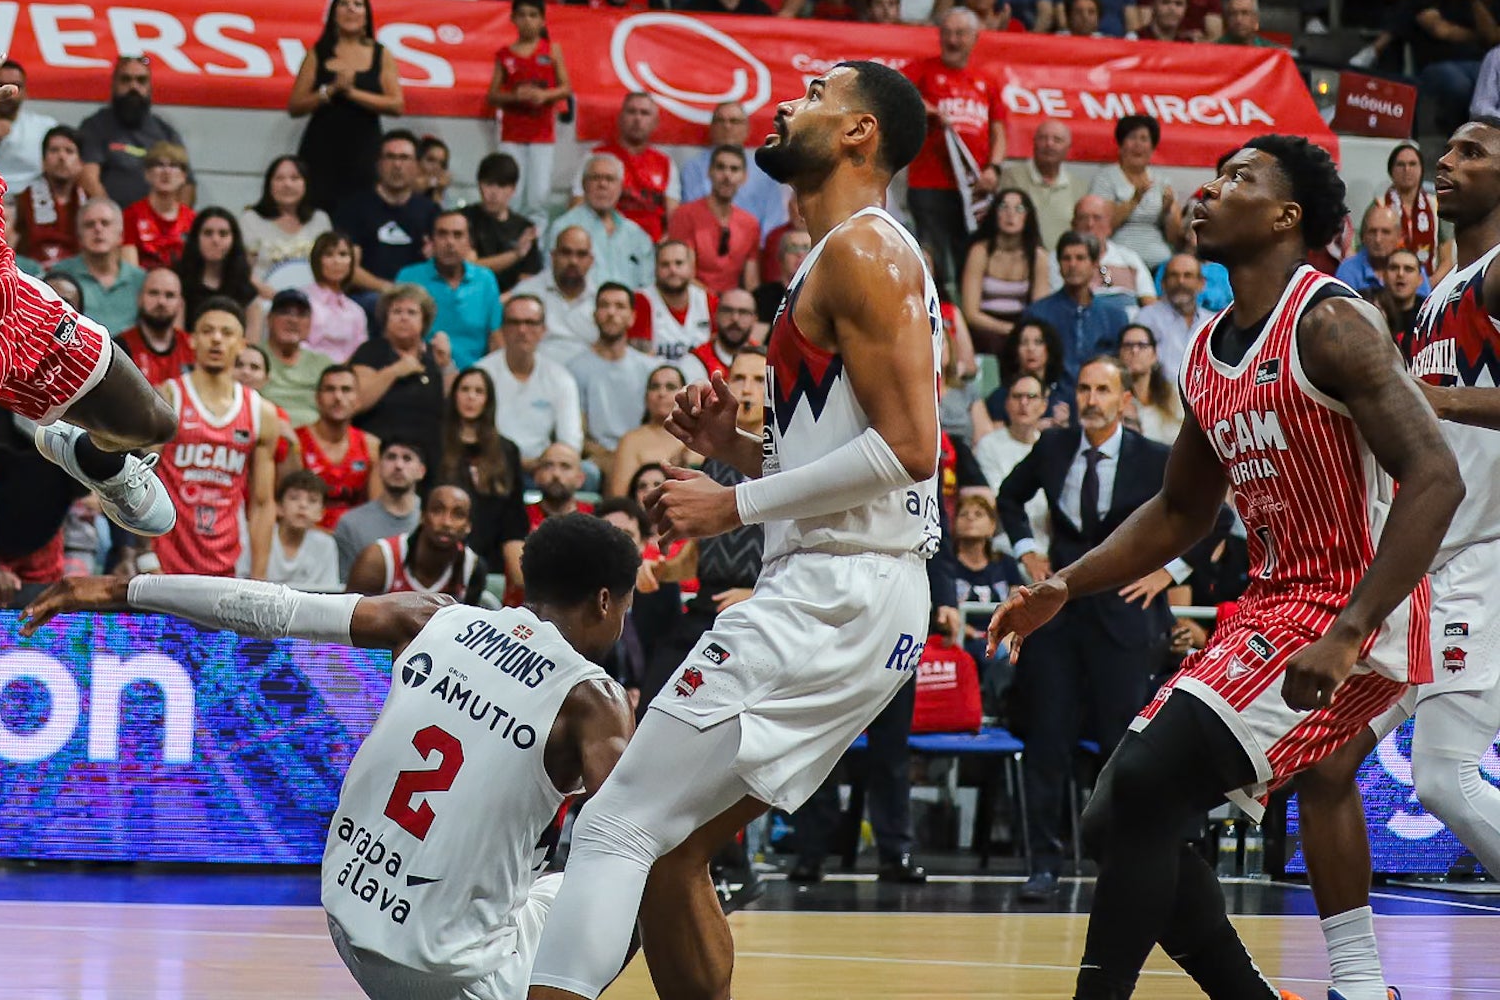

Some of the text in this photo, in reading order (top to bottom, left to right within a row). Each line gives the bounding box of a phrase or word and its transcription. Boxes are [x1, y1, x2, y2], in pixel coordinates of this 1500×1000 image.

[1002, 83, 1073, 117] DE
[174, 442, 247, 476] UCAM
[1248, 640, 1266, 655] acb
[1445, 626, 1464, 636] acb
[455, 619, 556, 689] SIMMONS
[703, 648, 720, 661] acb
[448, 666, 469, 682] GRUPO
[430, 675, 537, 750] AMUTIO
[384, 724, 465, 842] 2
[337, 816, 403, 878] araba
[337, 856, 412, 925] álava
